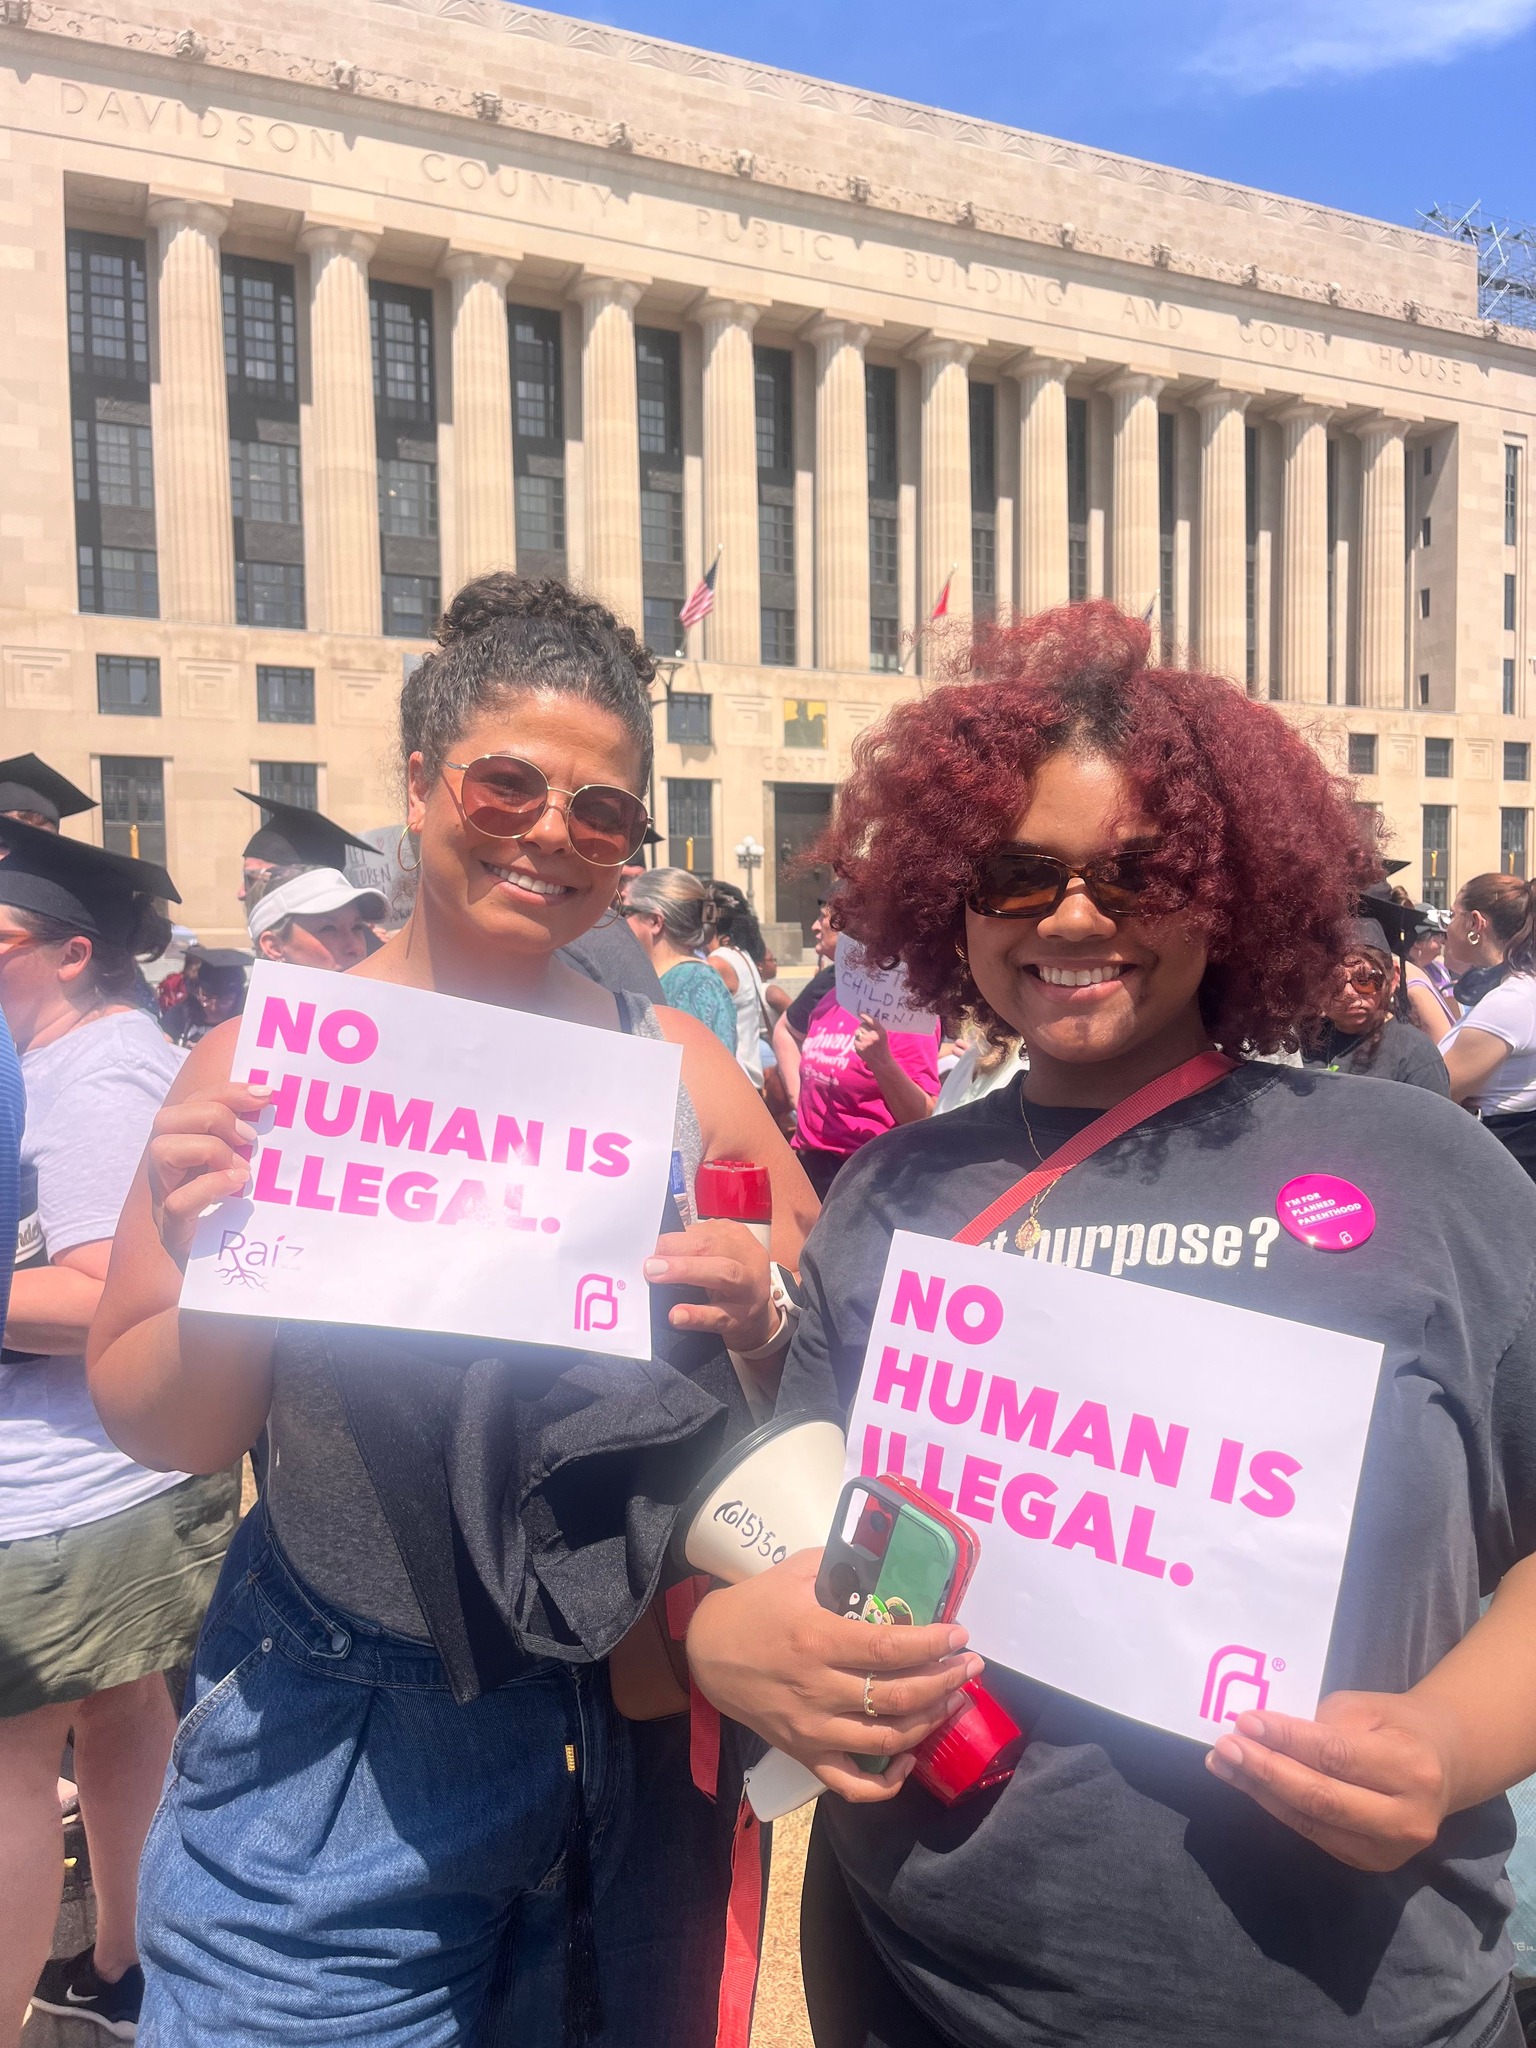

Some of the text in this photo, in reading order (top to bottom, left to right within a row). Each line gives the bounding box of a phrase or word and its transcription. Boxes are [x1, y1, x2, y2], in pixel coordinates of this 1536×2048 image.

[61, 82, 1462, 385] DAVIDSON COUNTY PUBLIC BUILDING AND COURT HOUSE
[762, 755, 828, 774] COURT
[842, 971, 908, 1011] CHILDR
[256, 997, 379, 1065] NO
[240, 1069, 544, 1168] HUMAN
[566, 1127, 633, 1178] IS
[1285, 1192, 1321, 1208] I'M FOR
[1291, 1199, 1336, 1217] PLANNED
[1297, 1202, 1362, 1226] PARENTHOOD
[890, 1269, 1004, 1345] NO
[873, 1346, 1303, 1518] HUMAN IS
[860, 1424, 1194, 1587] ILLEGAL.
